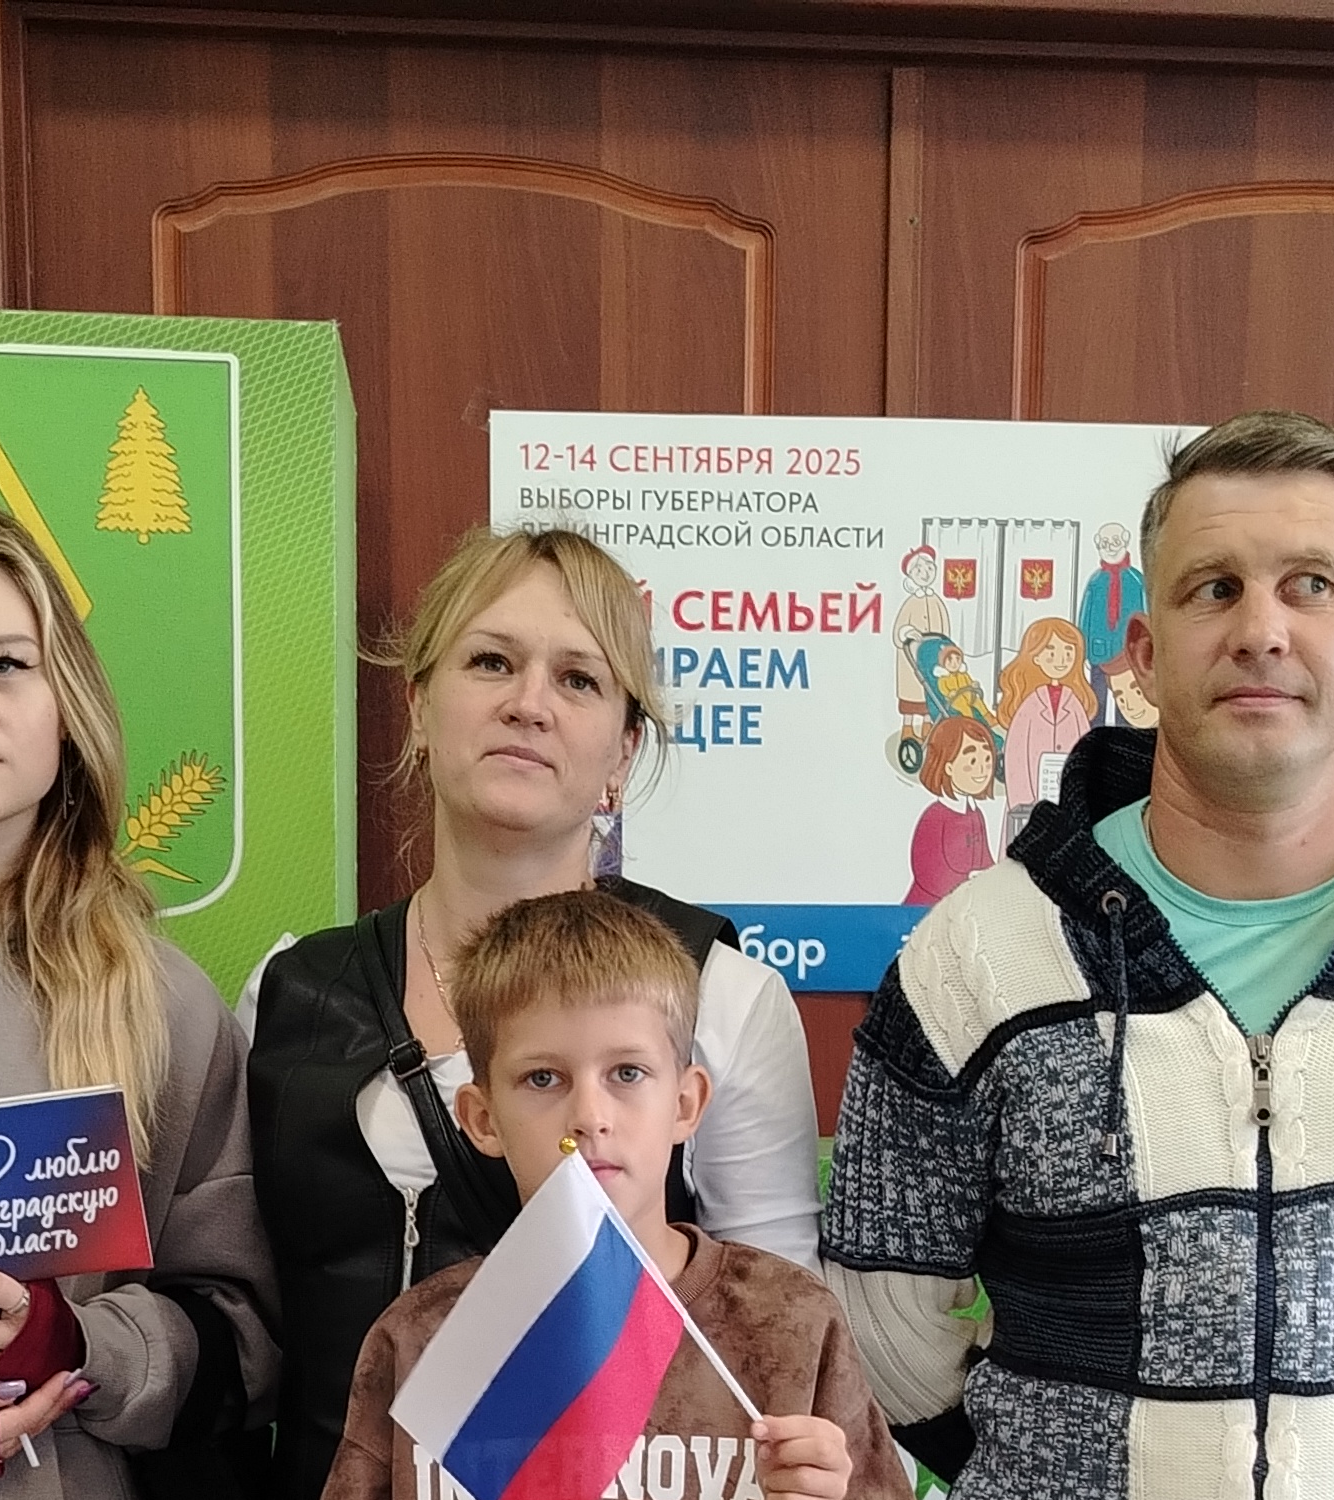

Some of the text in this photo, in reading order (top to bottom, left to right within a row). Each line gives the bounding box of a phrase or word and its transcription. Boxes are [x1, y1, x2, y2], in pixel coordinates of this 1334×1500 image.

[519, 444, 862, 475] 12-14 СЕНТЯБРЯ 2025
[519, 487, 819, 514] ВЫБОРЫ ГУБЕРНАТОРА
[762, 527, 884, 549] ОБЛАСТИ
[672, 582, 884, 634] СЕМЬЕЙ
[738, 924, 826, 980] бор
[25, 1137, 120, 1181] люблю
